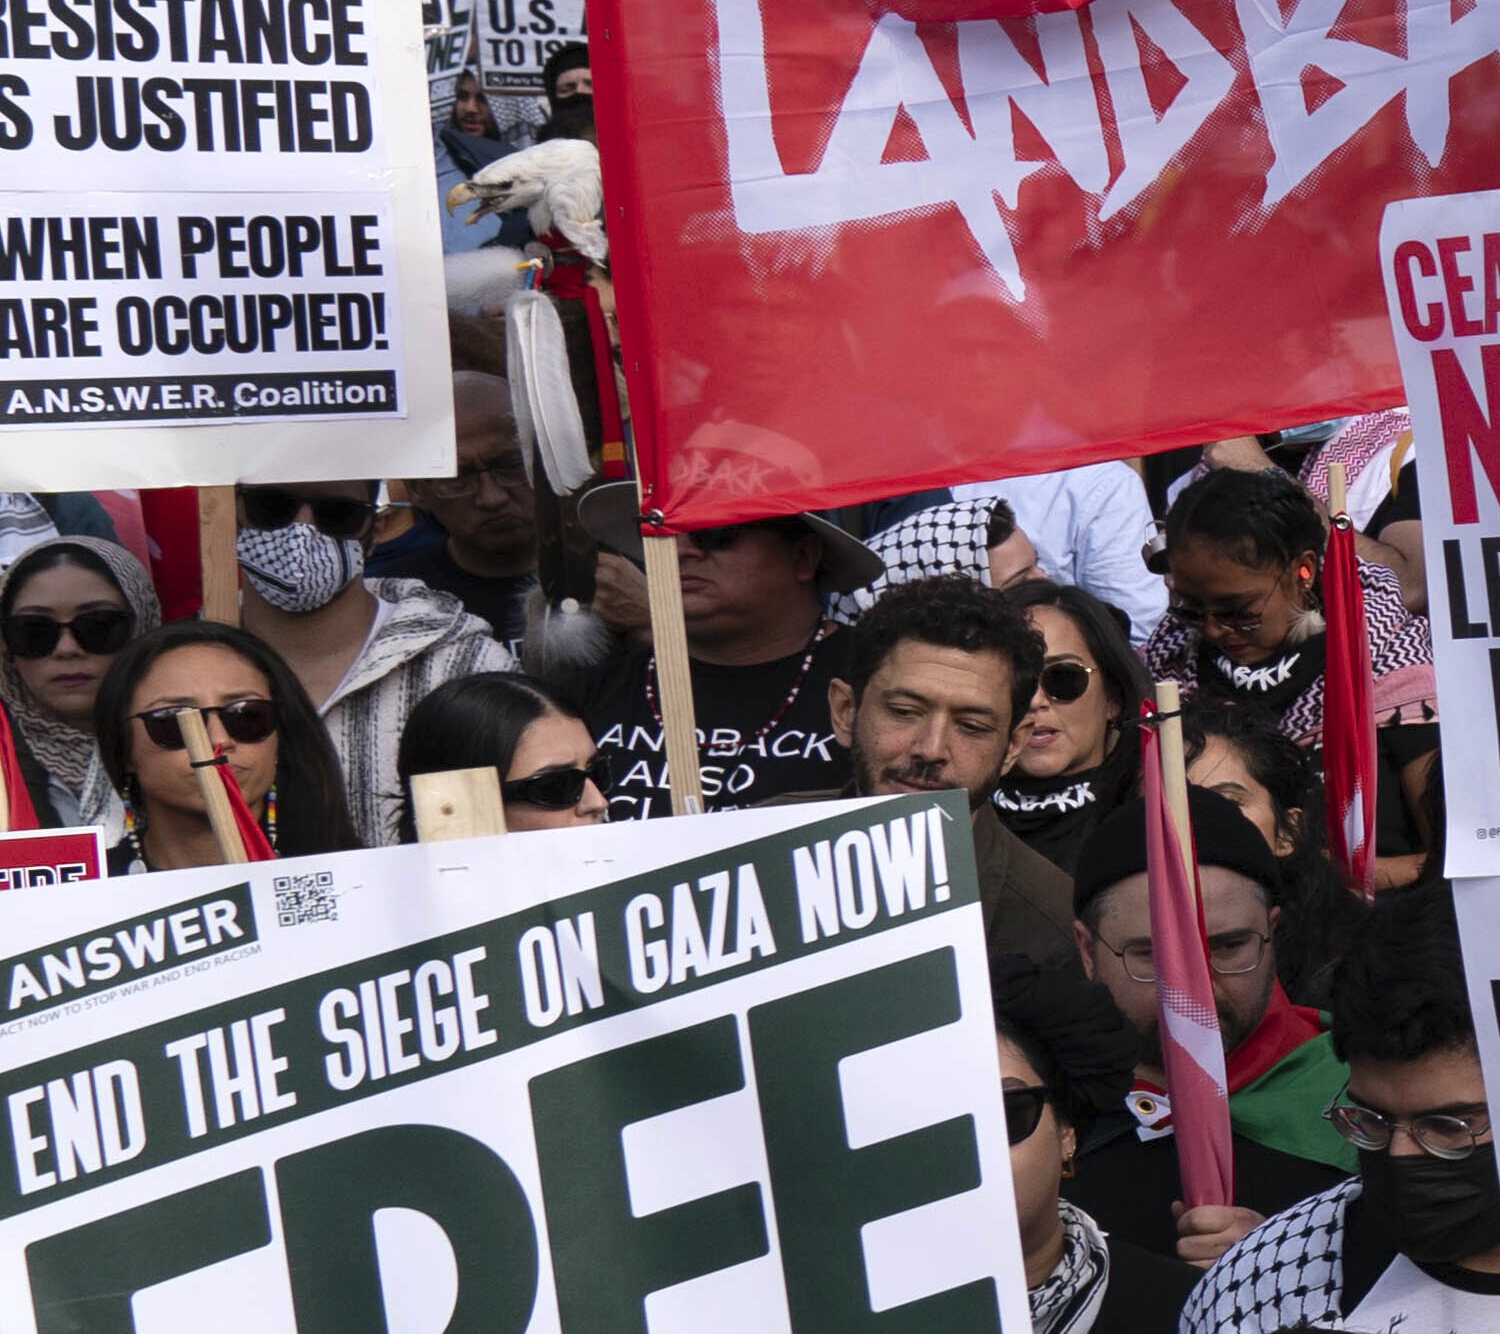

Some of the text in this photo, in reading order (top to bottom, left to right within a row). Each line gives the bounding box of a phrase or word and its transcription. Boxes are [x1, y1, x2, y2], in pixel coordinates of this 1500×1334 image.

[54, 76, 373, 154] JUSTIFIED
[0, 215, 383, 280] WHEN PEOPLE
[0, 292, 389, 358] ARE OCCUPIED!
[8, 380, 387, 415] A.N.S.W.E.R. Coalition
[5, 897, 243, 1007] ANSWER
[9, 808, 952, 1187] END THE SIEGE ON GAZA NOW!
